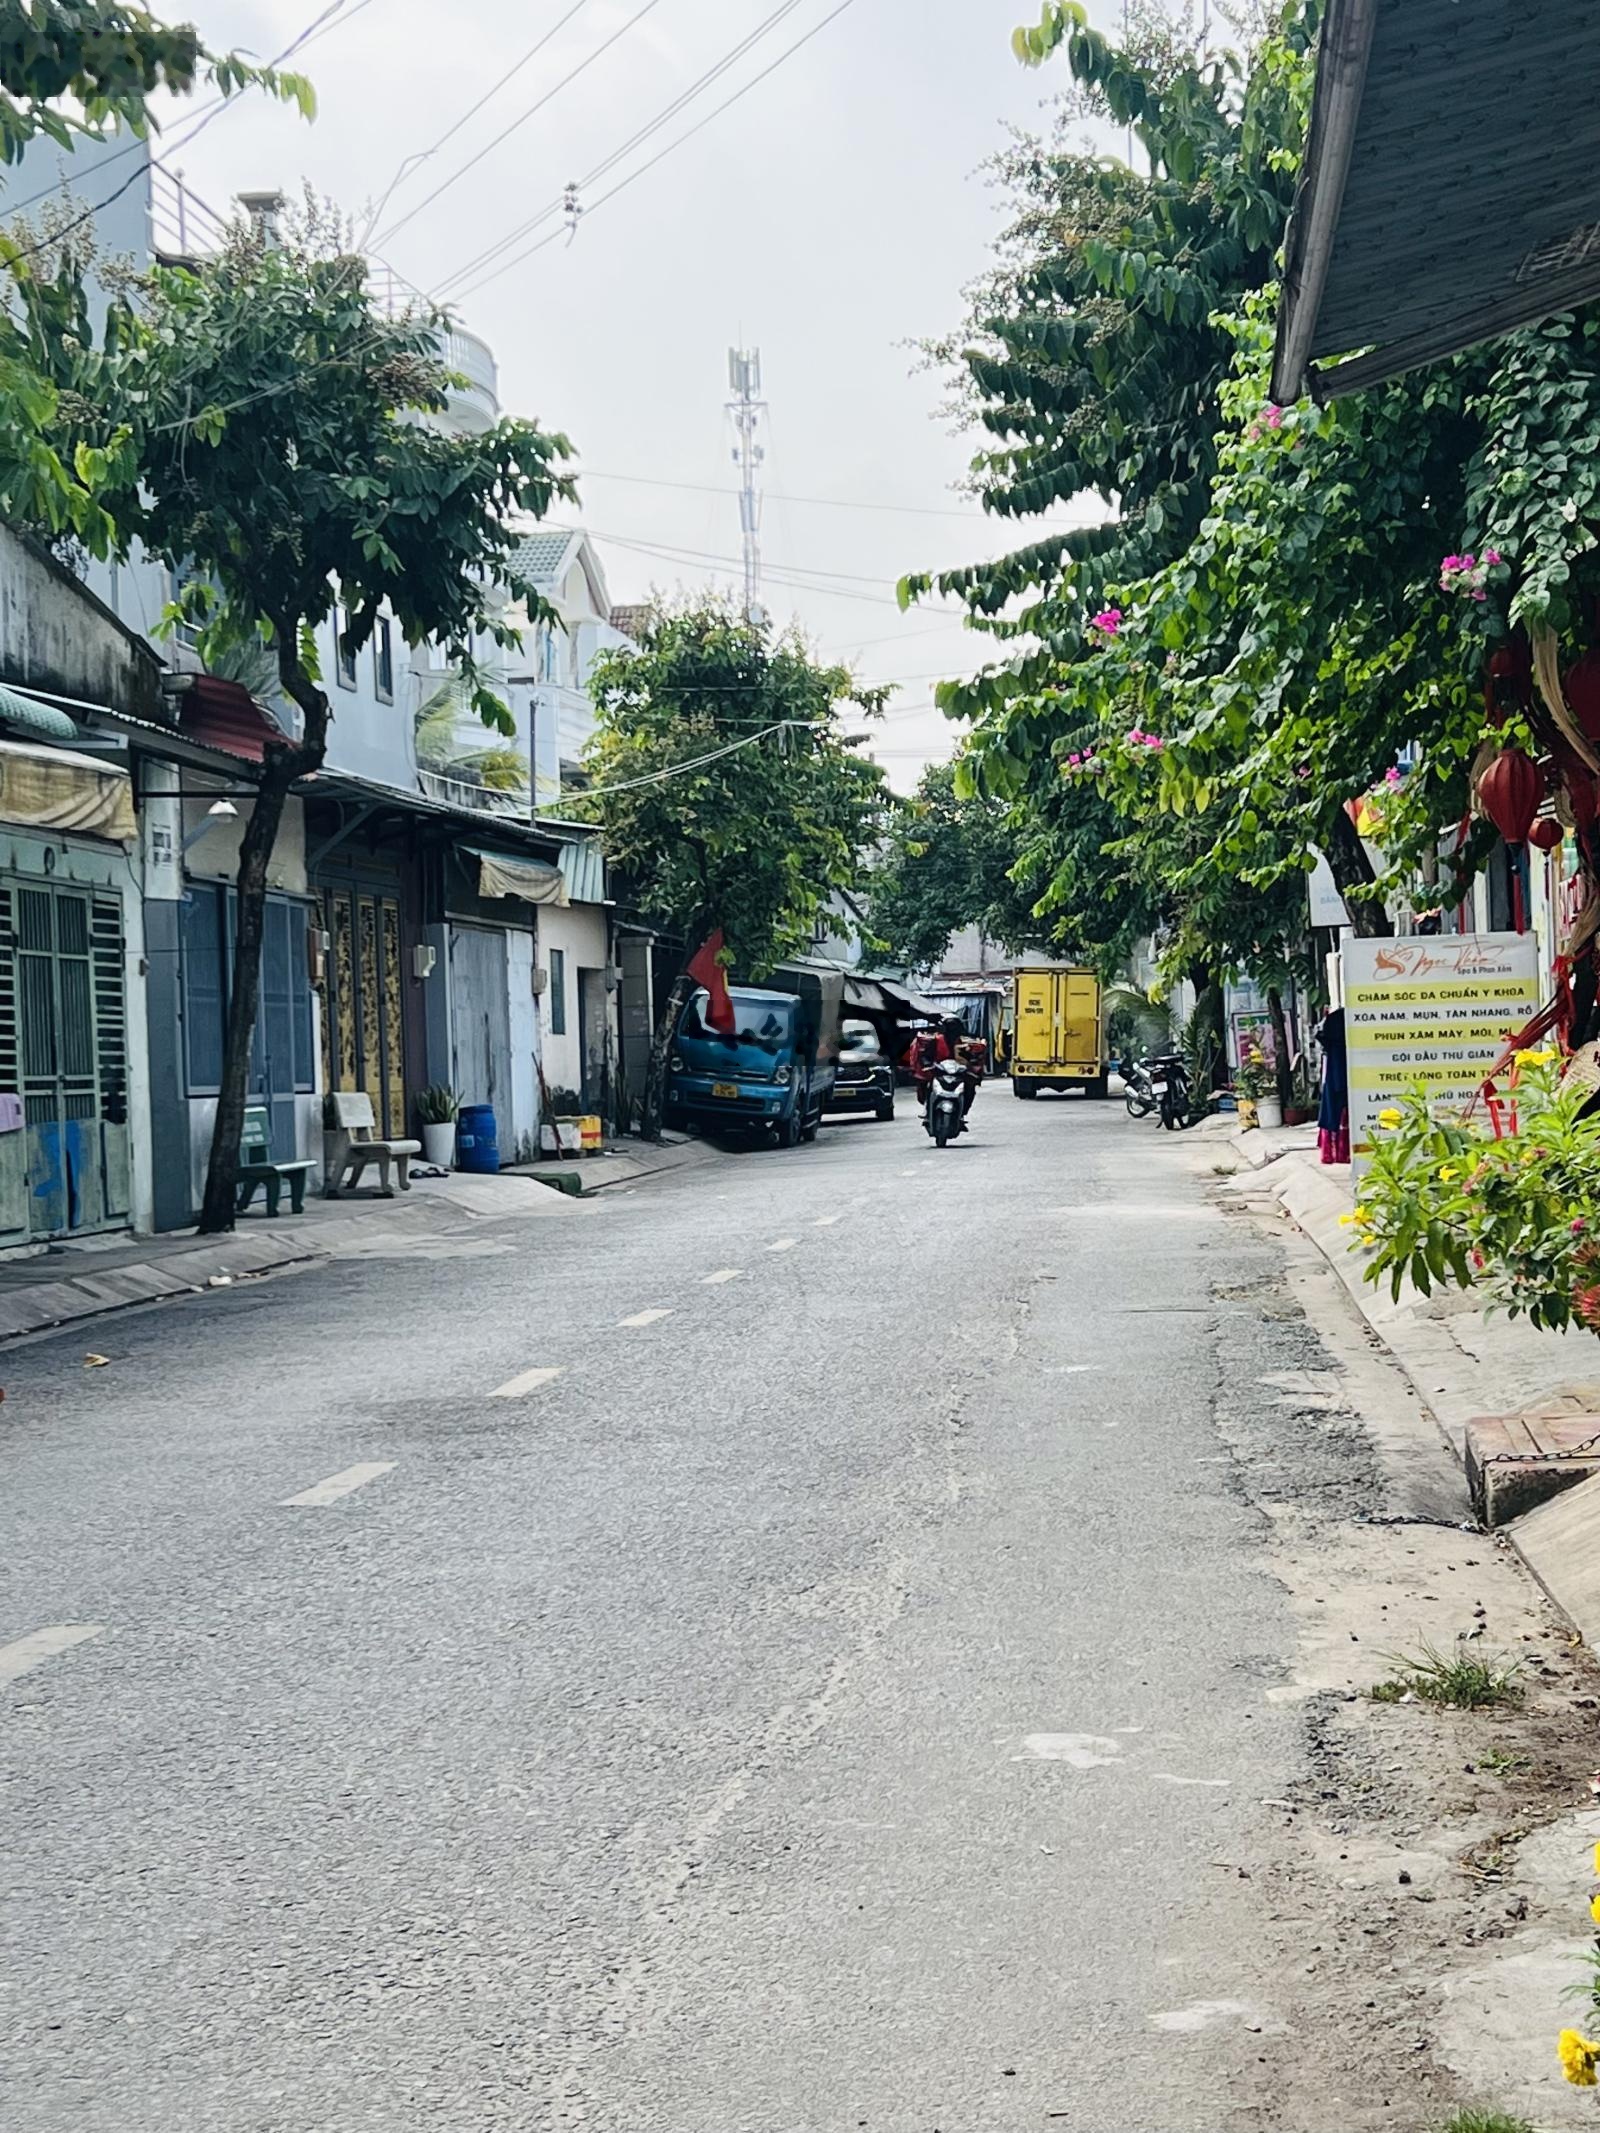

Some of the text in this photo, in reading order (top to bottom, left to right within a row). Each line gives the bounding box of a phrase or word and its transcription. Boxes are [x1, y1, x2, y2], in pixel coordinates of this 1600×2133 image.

[1483, 989, 1490, 997] Y
[1494, 987, 1525, 997] KHOA
[1374, 1032, 1405, 1041] PHUN
